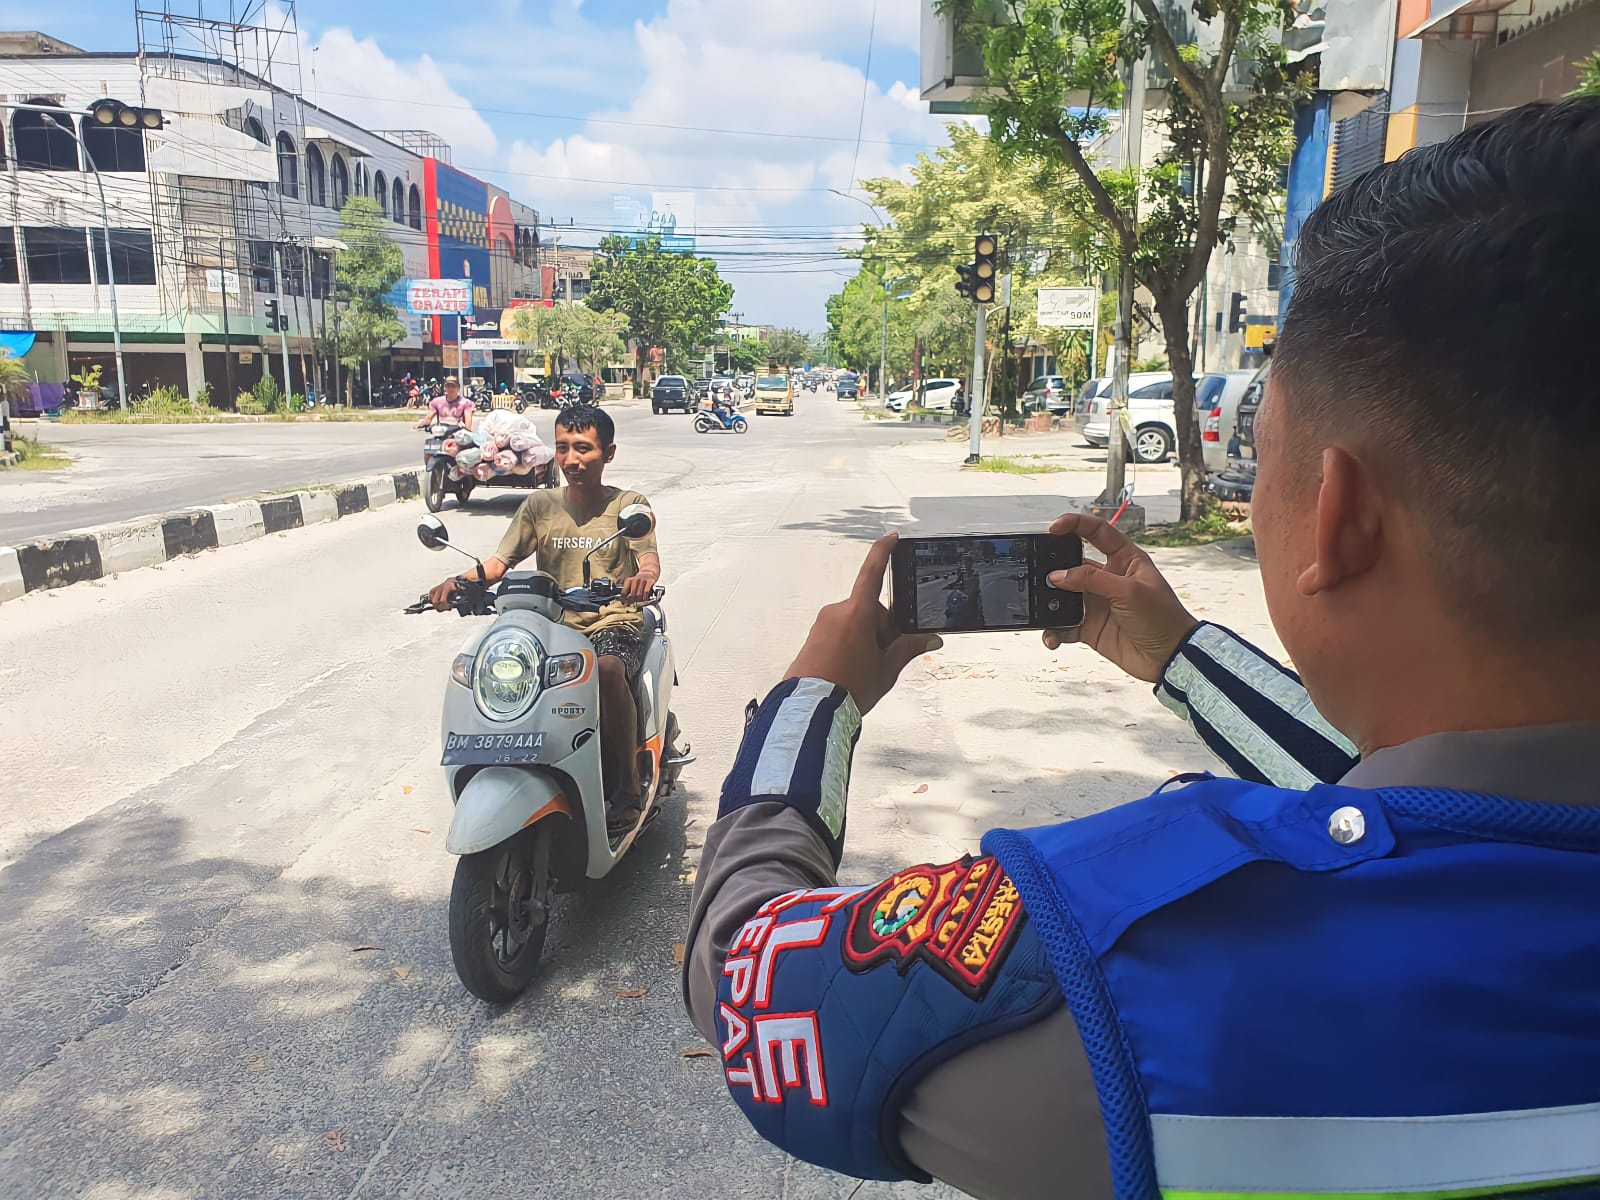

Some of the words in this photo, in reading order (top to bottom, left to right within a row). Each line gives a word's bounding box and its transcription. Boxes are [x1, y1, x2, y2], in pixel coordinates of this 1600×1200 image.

[412, 288, 467, 298] TERAPI
[413, 300, 468, 311] GRATIS
[447, 735, 469, 750] BM
[475, 735, 513, 749] 3879
[514, 734, 543, 748] AAA
[938, 863, 988, 943] RIAU
[720, 888, 806, 1103] CEPAT
